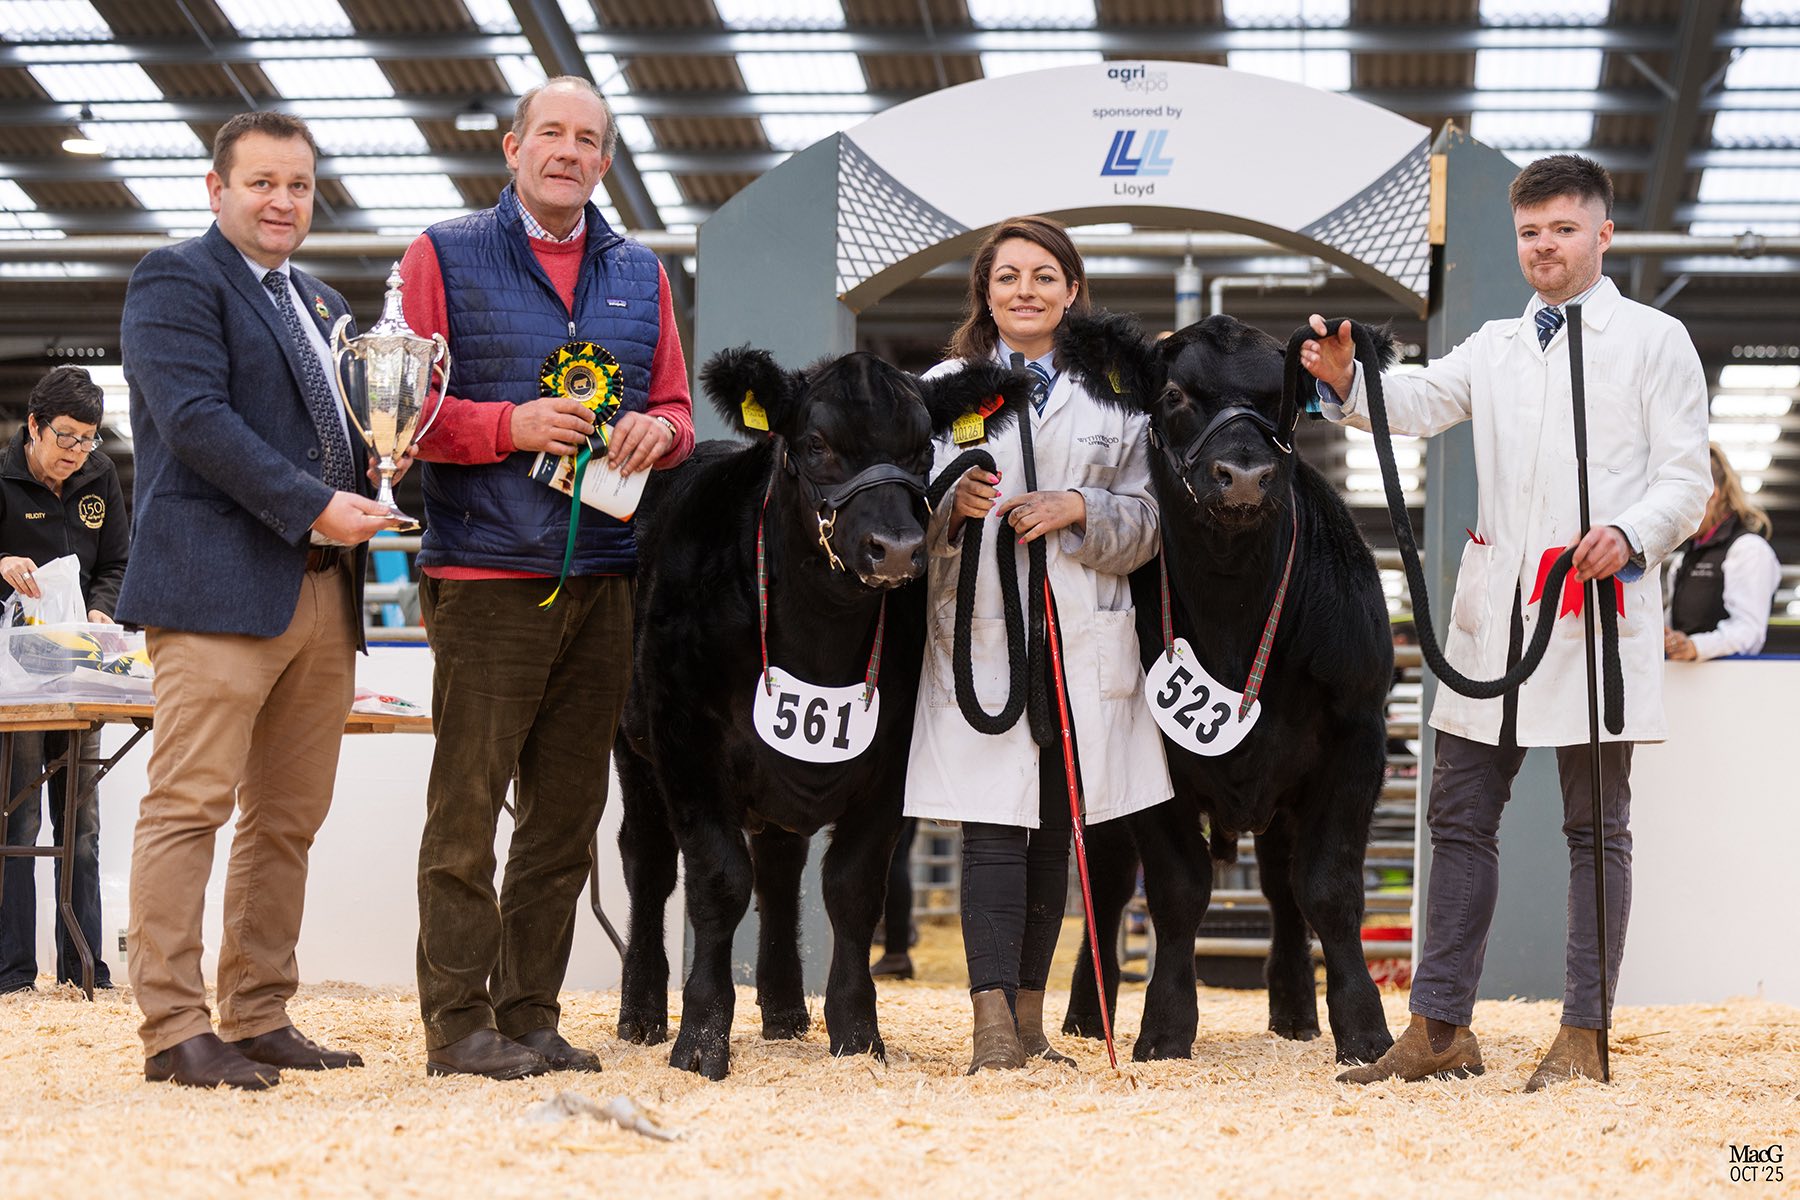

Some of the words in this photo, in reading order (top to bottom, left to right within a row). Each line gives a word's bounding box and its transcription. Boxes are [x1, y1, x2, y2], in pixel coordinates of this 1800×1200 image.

[1108, 64, 1145, 83] agri
[1125, 79, 1169, 95] expo
[1092, 106, 1163, 119] sponsored
[1167, 106, 1183, 119] by
[1114, 183, 1155, 198] Lloyd
[82, 501, 103, 516] 150
[1156, 665, 1231, 744] 523
[773, 692, 852, 749] 561
